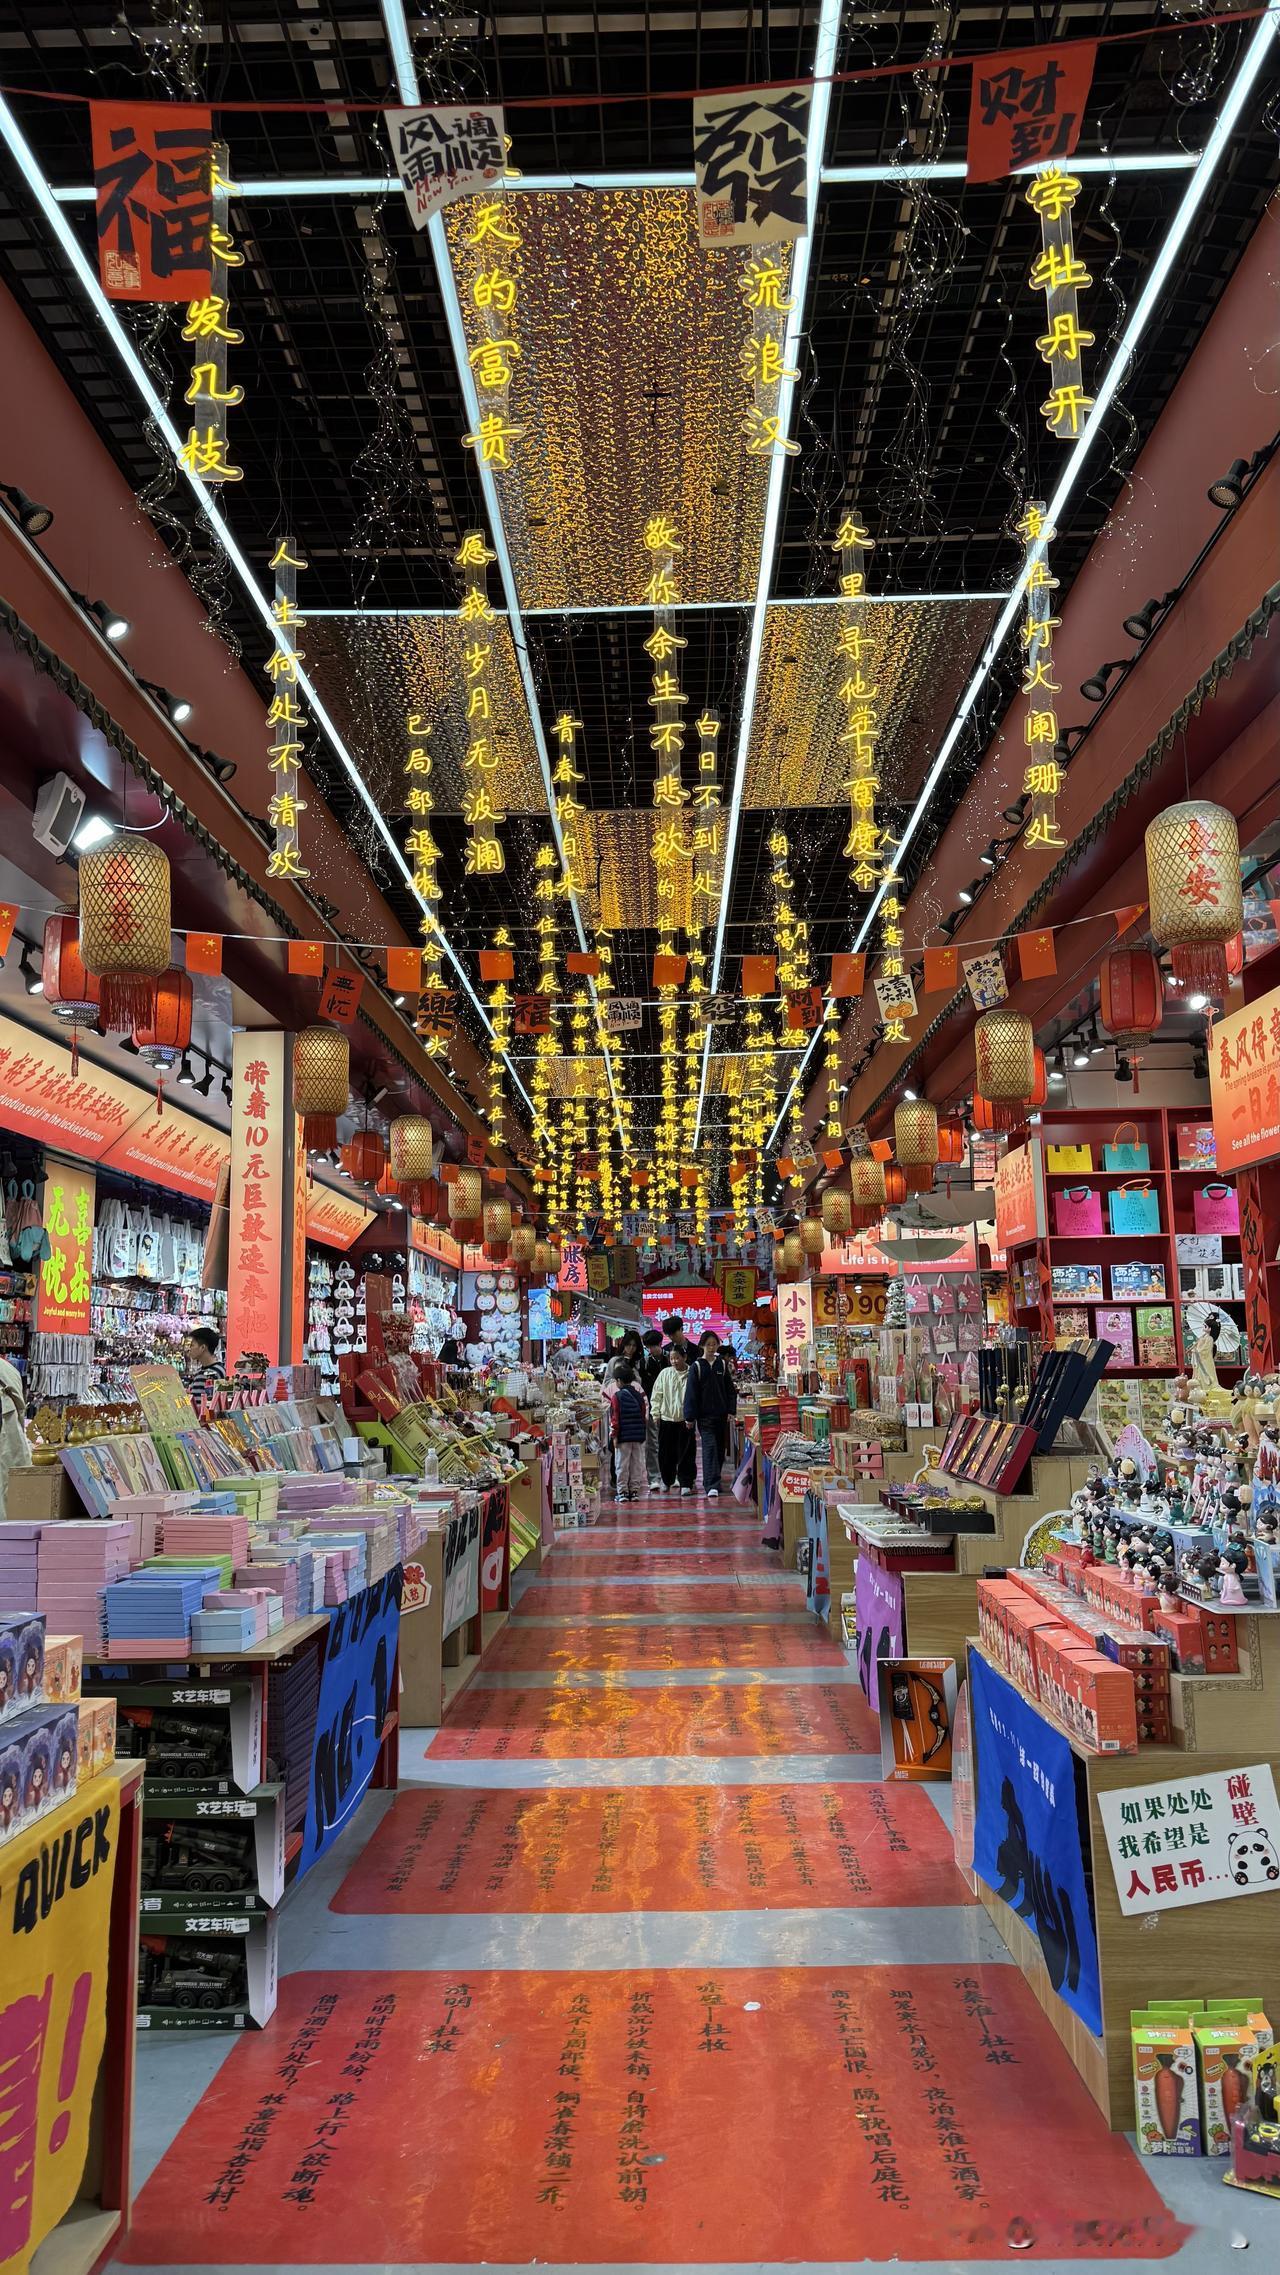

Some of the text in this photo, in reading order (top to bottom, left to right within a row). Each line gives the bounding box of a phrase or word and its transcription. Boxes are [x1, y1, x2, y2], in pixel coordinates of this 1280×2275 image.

[93, 126, 213, 278] 福
[738, 257, 801, 456] 流浪汉
[1025, 169, 1098, 439] 学牡丹开
[264, 542, 309, 878] 人生何处不清欢
[455, 532, 505, 874] 愿我岁月无波澜
[644, 516, 693, 860] 敬你余生不悲欢
[833, 520, 882, 860] 众里寻他千百度
[1016, 508, 1068, 849] 竟在灯火阑珊处
[552, 714, 588, 897] 青春恰自来
[692, 714, 724, 898] 白日不到处
[879, 830, 911, 1044] 人生得意须欢
[562, 1244, 584, 1284] 账房
[841, 1254, 866, 1265] Life
[867, 1254, 878, 1265] is
[13, 1804, 111, 1935] QUICK
[1116, 1828, 1211, 1860] 我希望是
[1120, 1787, 1213, 1825] 如果处处
[1224, 1773, 1261, 1828] 碰壁
